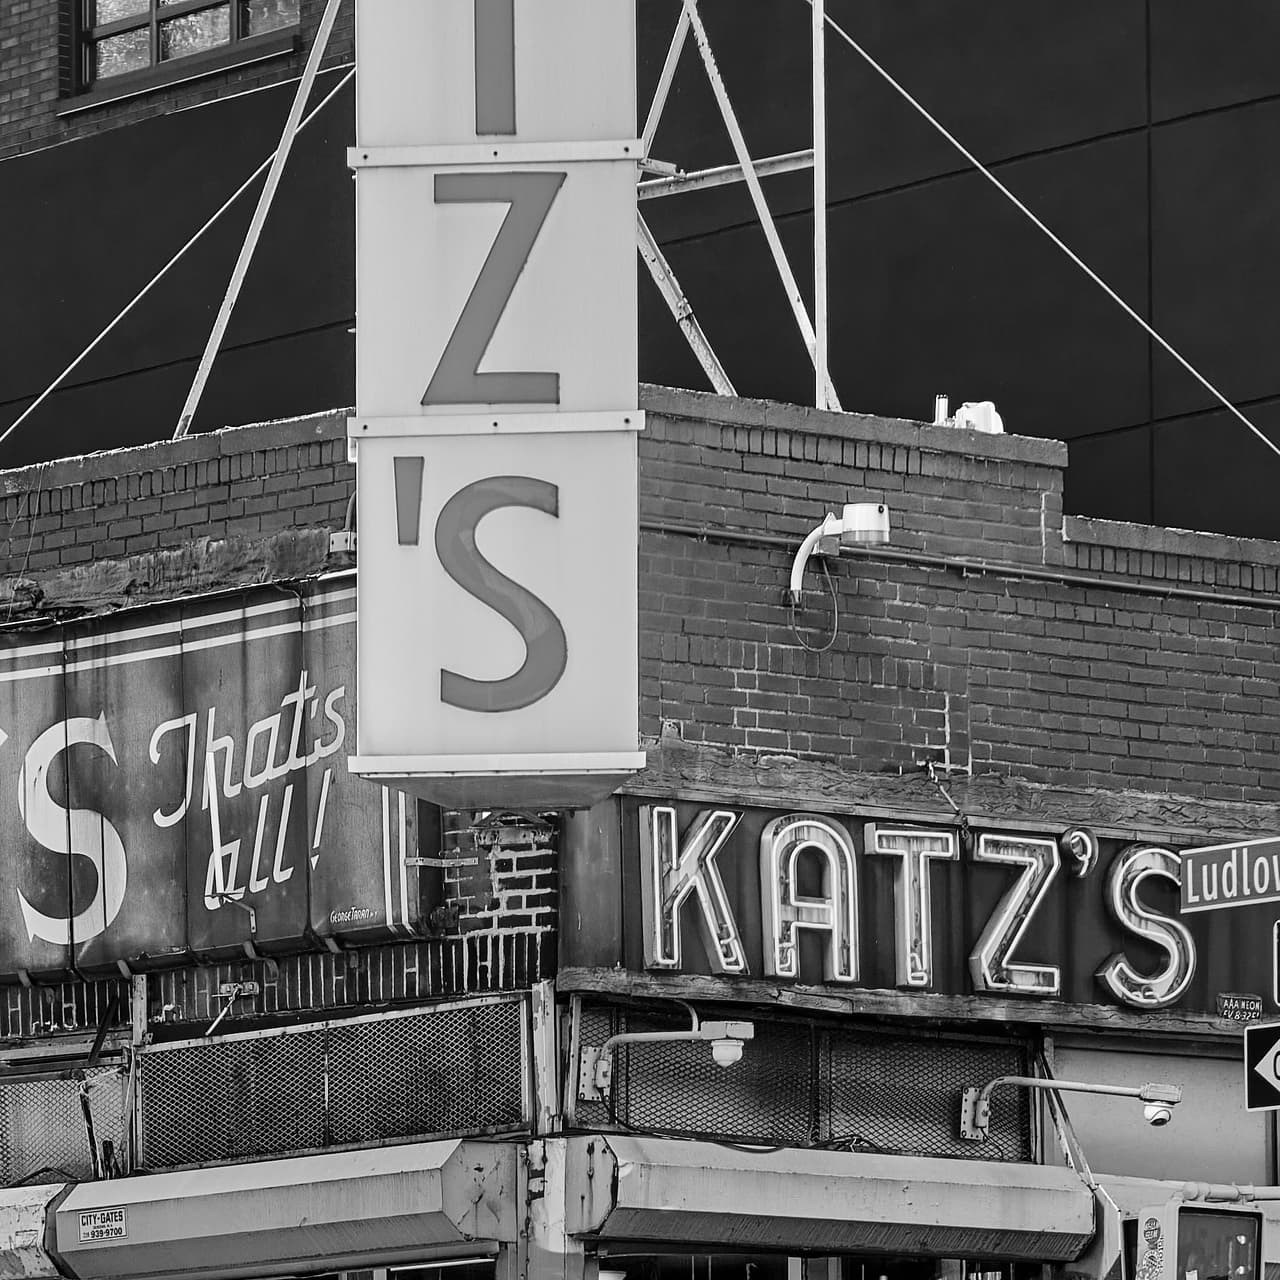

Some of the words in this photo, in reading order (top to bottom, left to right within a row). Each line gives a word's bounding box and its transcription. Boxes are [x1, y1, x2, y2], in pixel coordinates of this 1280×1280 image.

[149, 671, 347, 828] That's
[638, 803, 1197, 1009] KATZ'S
[1241, 1000, 1260, 1011] NEON
